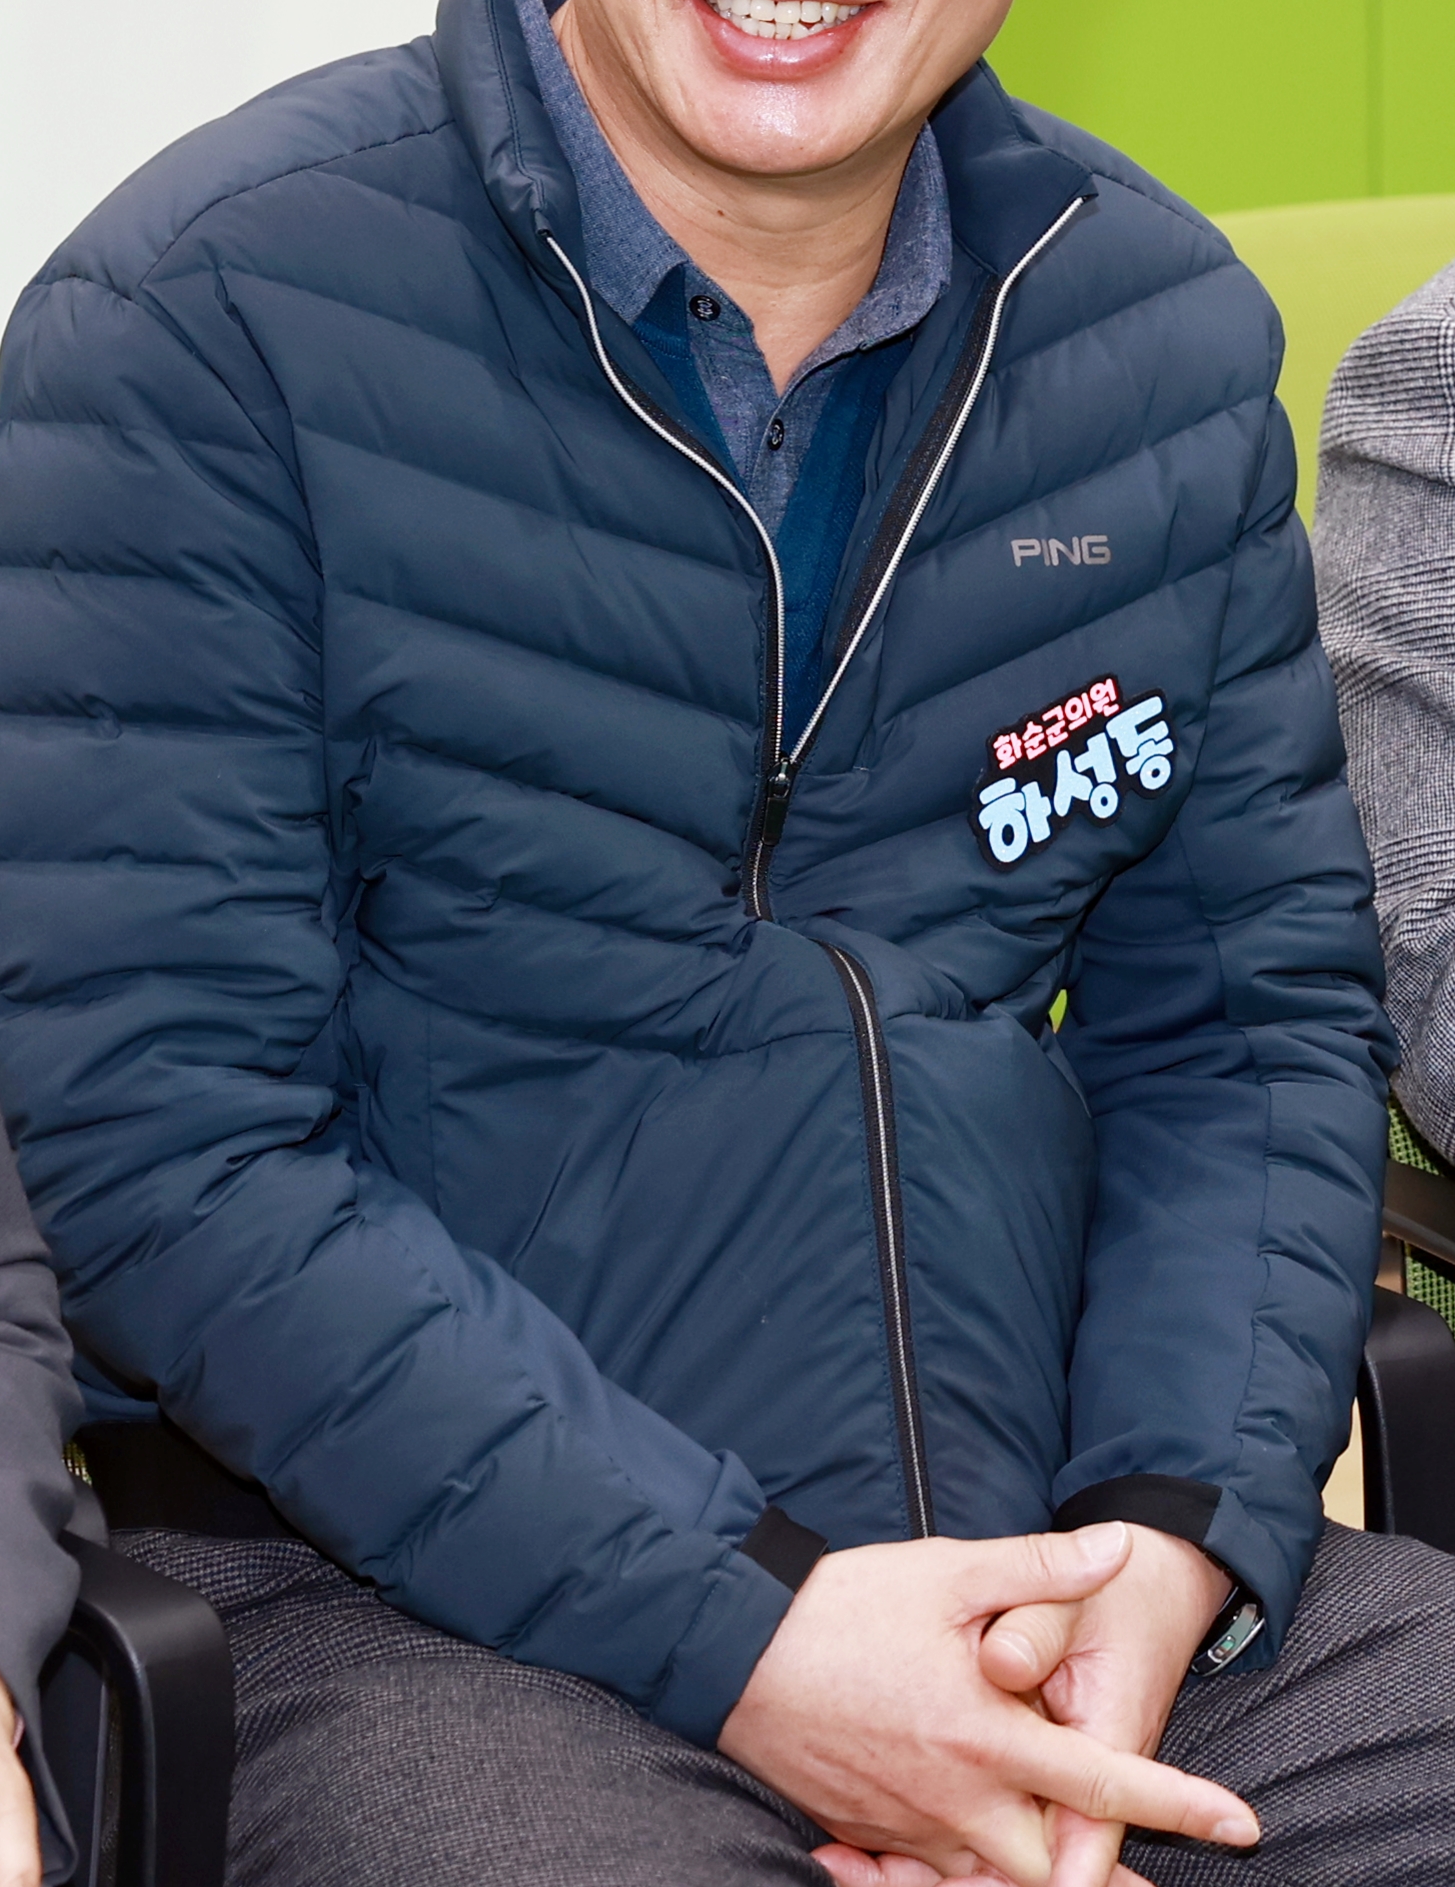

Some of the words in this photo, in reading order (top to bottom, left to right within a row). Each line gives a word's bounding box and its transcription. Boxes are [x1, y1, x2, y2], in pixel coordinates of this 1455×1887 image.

[1010, 534, 1112, 567] PING
[993, 677, 1121, 771] 화순군의원
[978, 695, 1175, 863] 하성동
